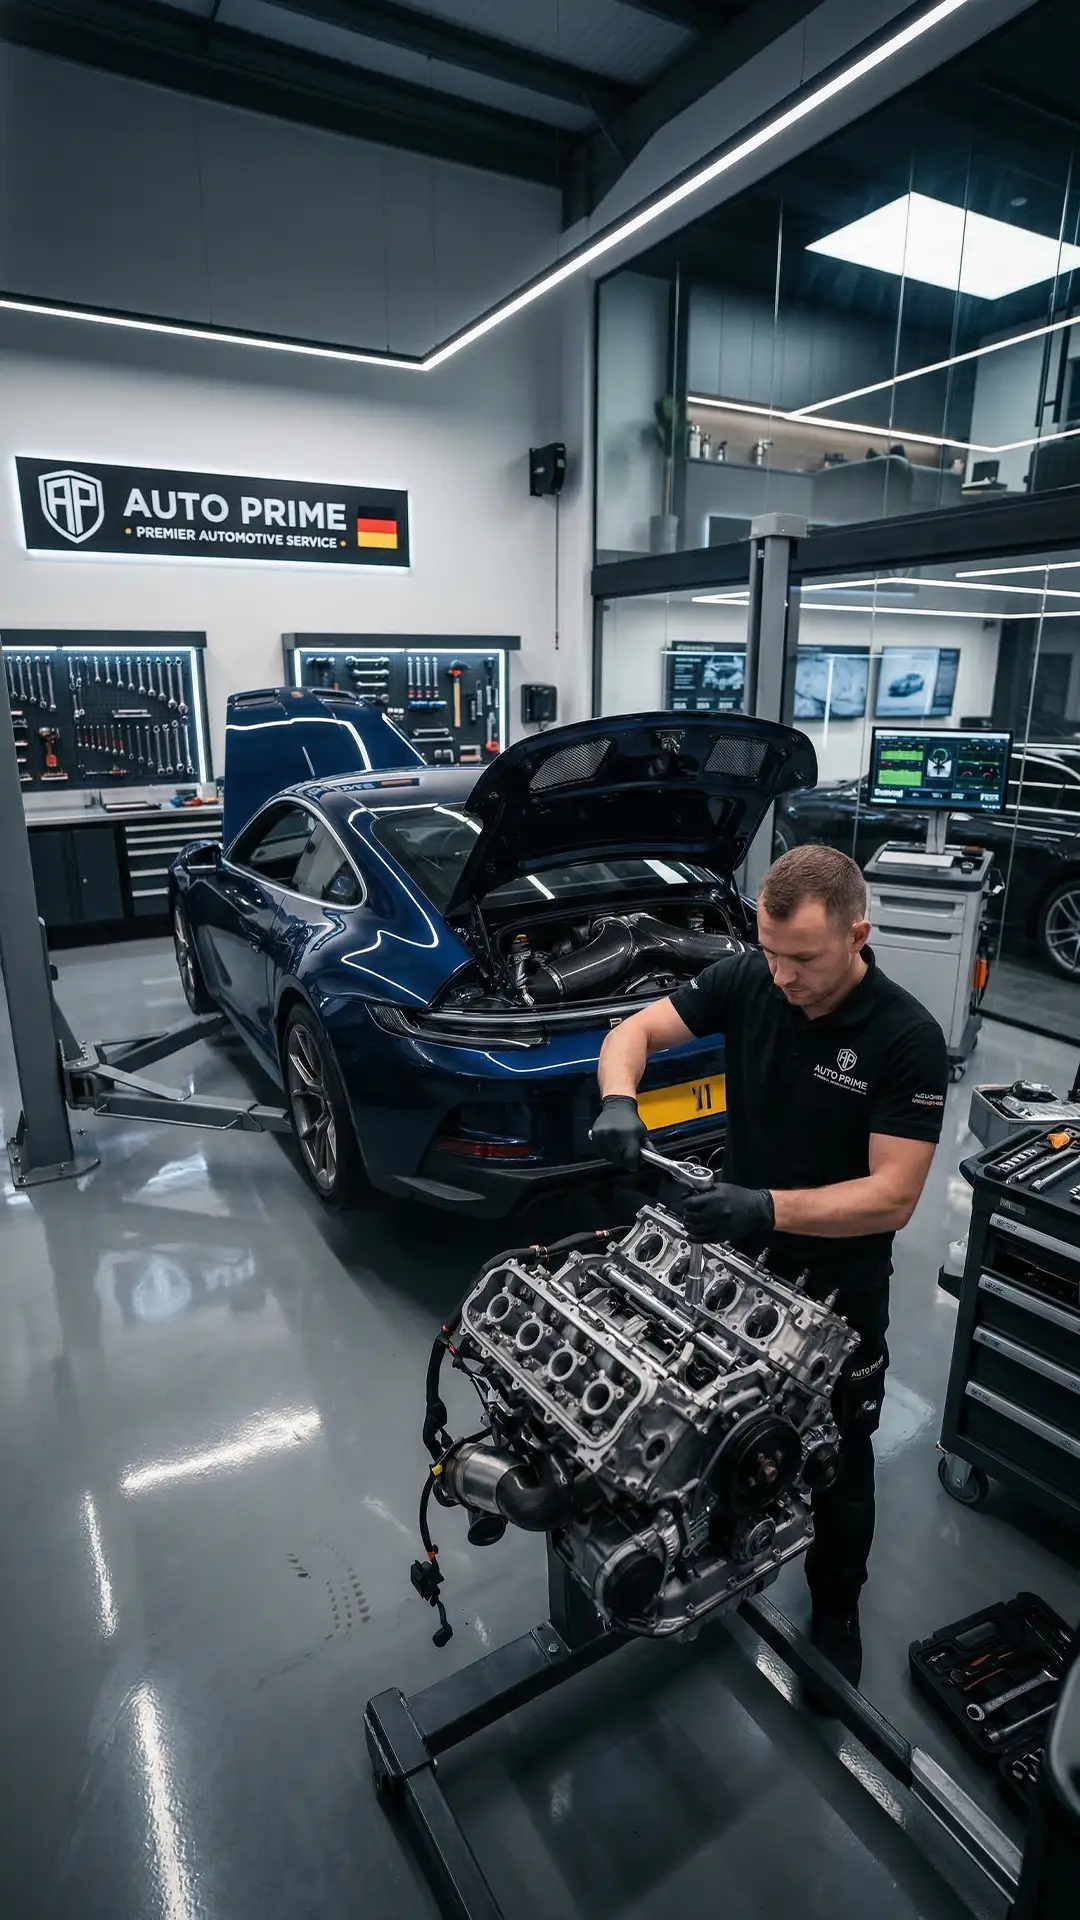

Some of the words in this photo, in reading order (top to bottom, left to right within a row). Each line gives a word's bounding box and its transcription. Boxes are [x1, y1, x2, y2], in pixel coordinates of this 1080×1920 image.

[123, 488, 229, 523] AUTO
[240, 496, 347, 531] PRIME
[136, 526, 196, 541] PREMIER
[198, 530, 284, 546] AUTOMOTIVE
[286, 534, 338, 549] SERVICE
[813, 1064, 838, 1080] AUTO
[838, 1074, 868, 1091] PRIME
[851, 1367, 870, 1378] AUTO
